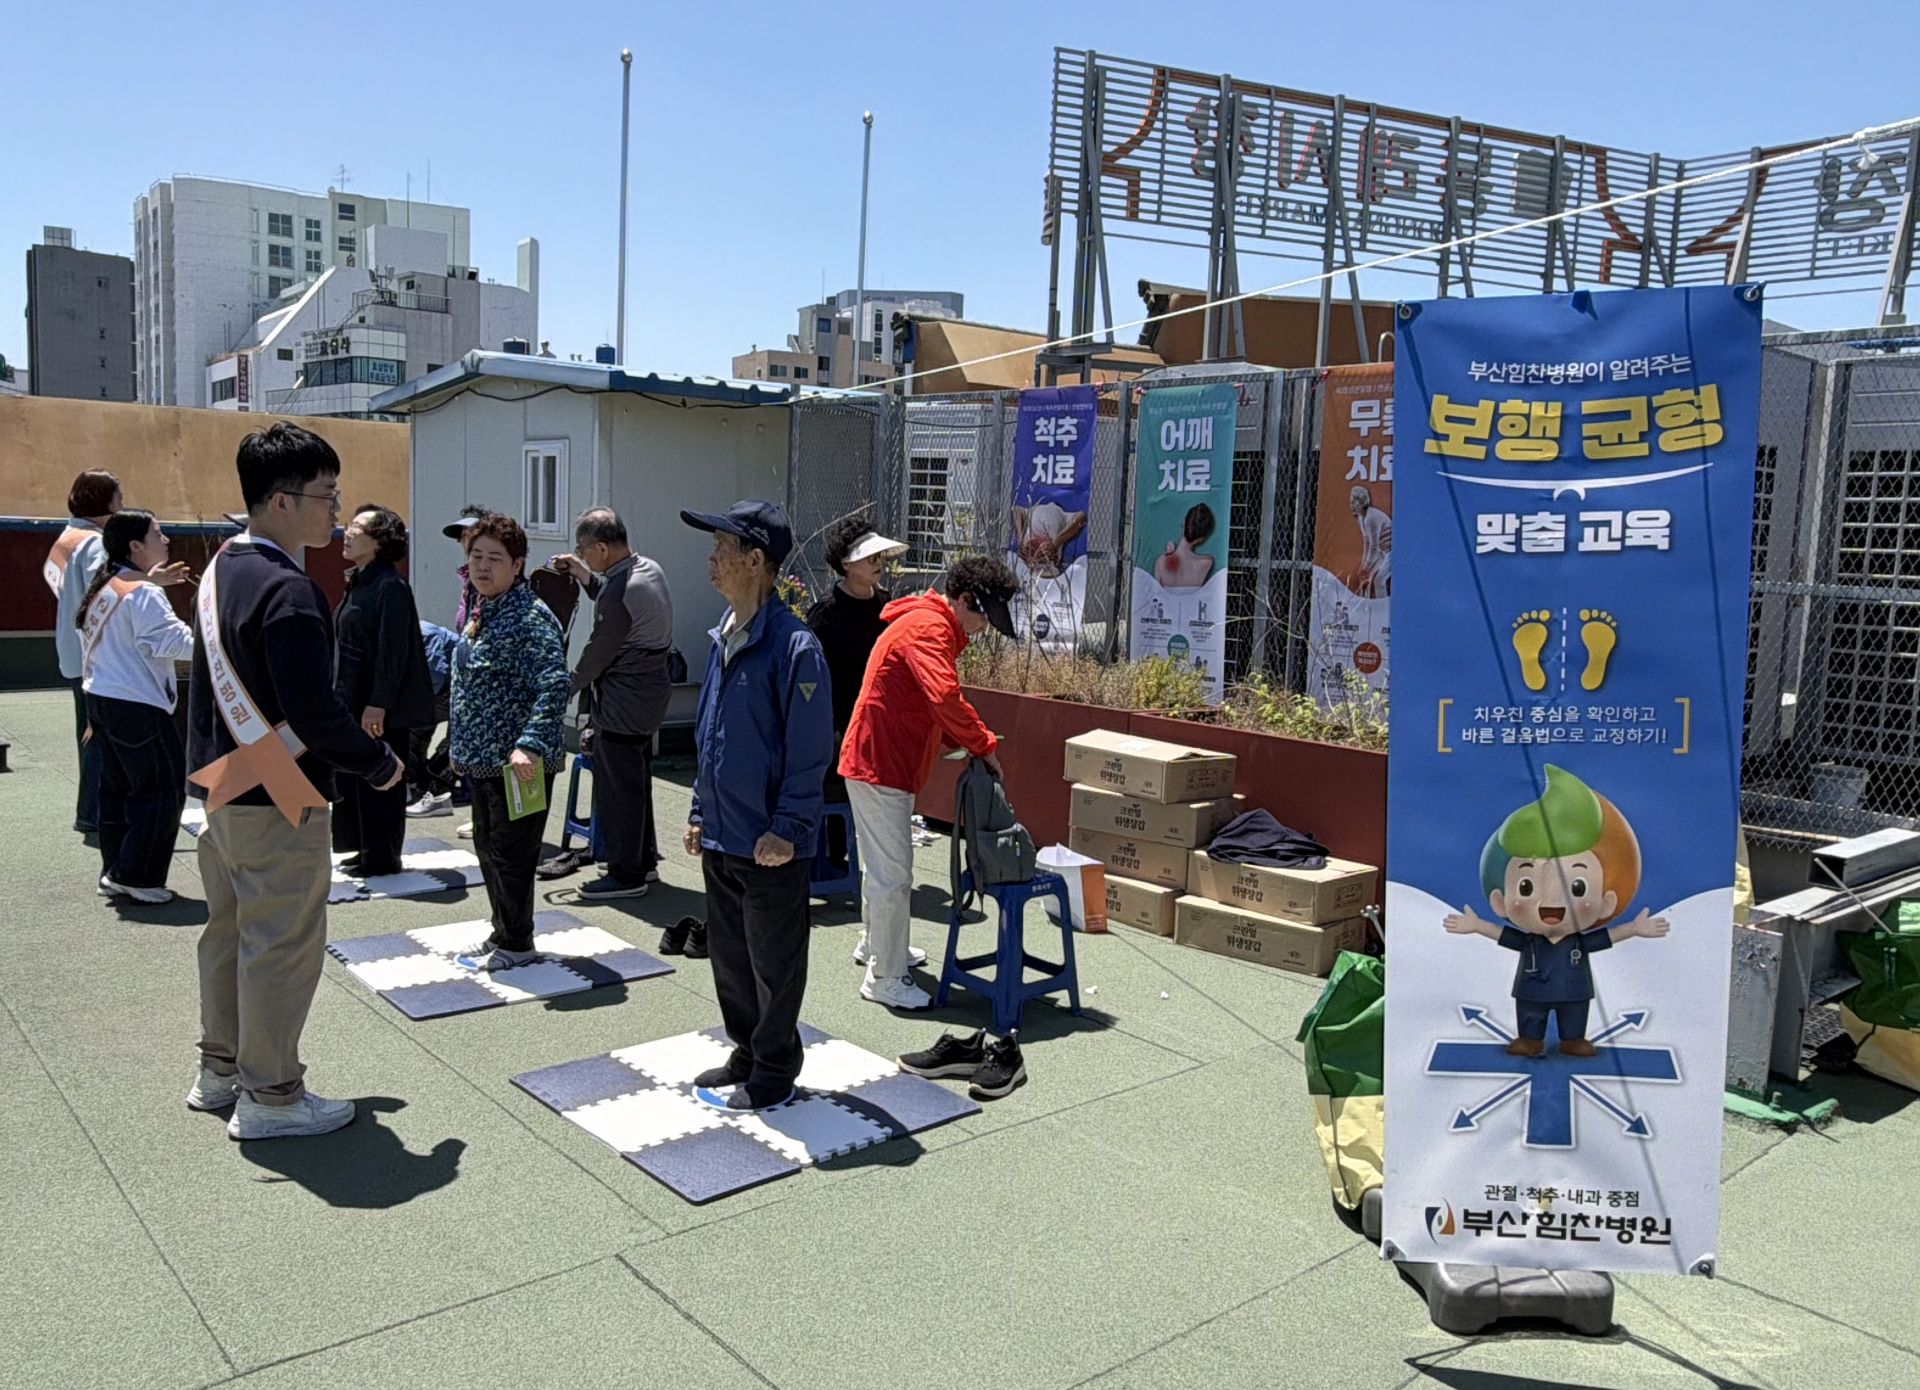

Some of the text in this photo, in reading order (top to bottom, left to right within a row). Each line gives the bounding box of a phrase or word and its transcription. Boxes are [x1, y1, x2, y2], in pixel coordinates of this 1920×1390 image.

[1467, 353, 1692, 385] 부산힘찬병원이 알려주는
[1034, 415, 1078, 447] 척추
[1160, 416, 1214, 451] 어깨
[1424, 384, 1724, 462] 보행 균형
[1031, 454, 1075, 484] 치료
[1158, 458, 1211, 492] 치료
[1476, 509, 1672, 554] 맞춤 교육
[1530, 705, 1581, 723] 중심을
[1586, 705, 1656, 723] 확인하고
[1462, 725, 1667, 746] 바른 걸음법으로 교정하기!
[1100, 770, 1125, 786] 위생장갑
[1114, 815, 1146, 832] 위생장갑
[1111, 853, 1141, 870] 위생장갑
[1231, 885, 1264, 903] 위생장갑
[1226, 936, 1263, 953] 위생장갑
[1607, 1189, 1640, 1207] 중점
[1463, 1208, 1672, 1245] 부산힘찬병원
